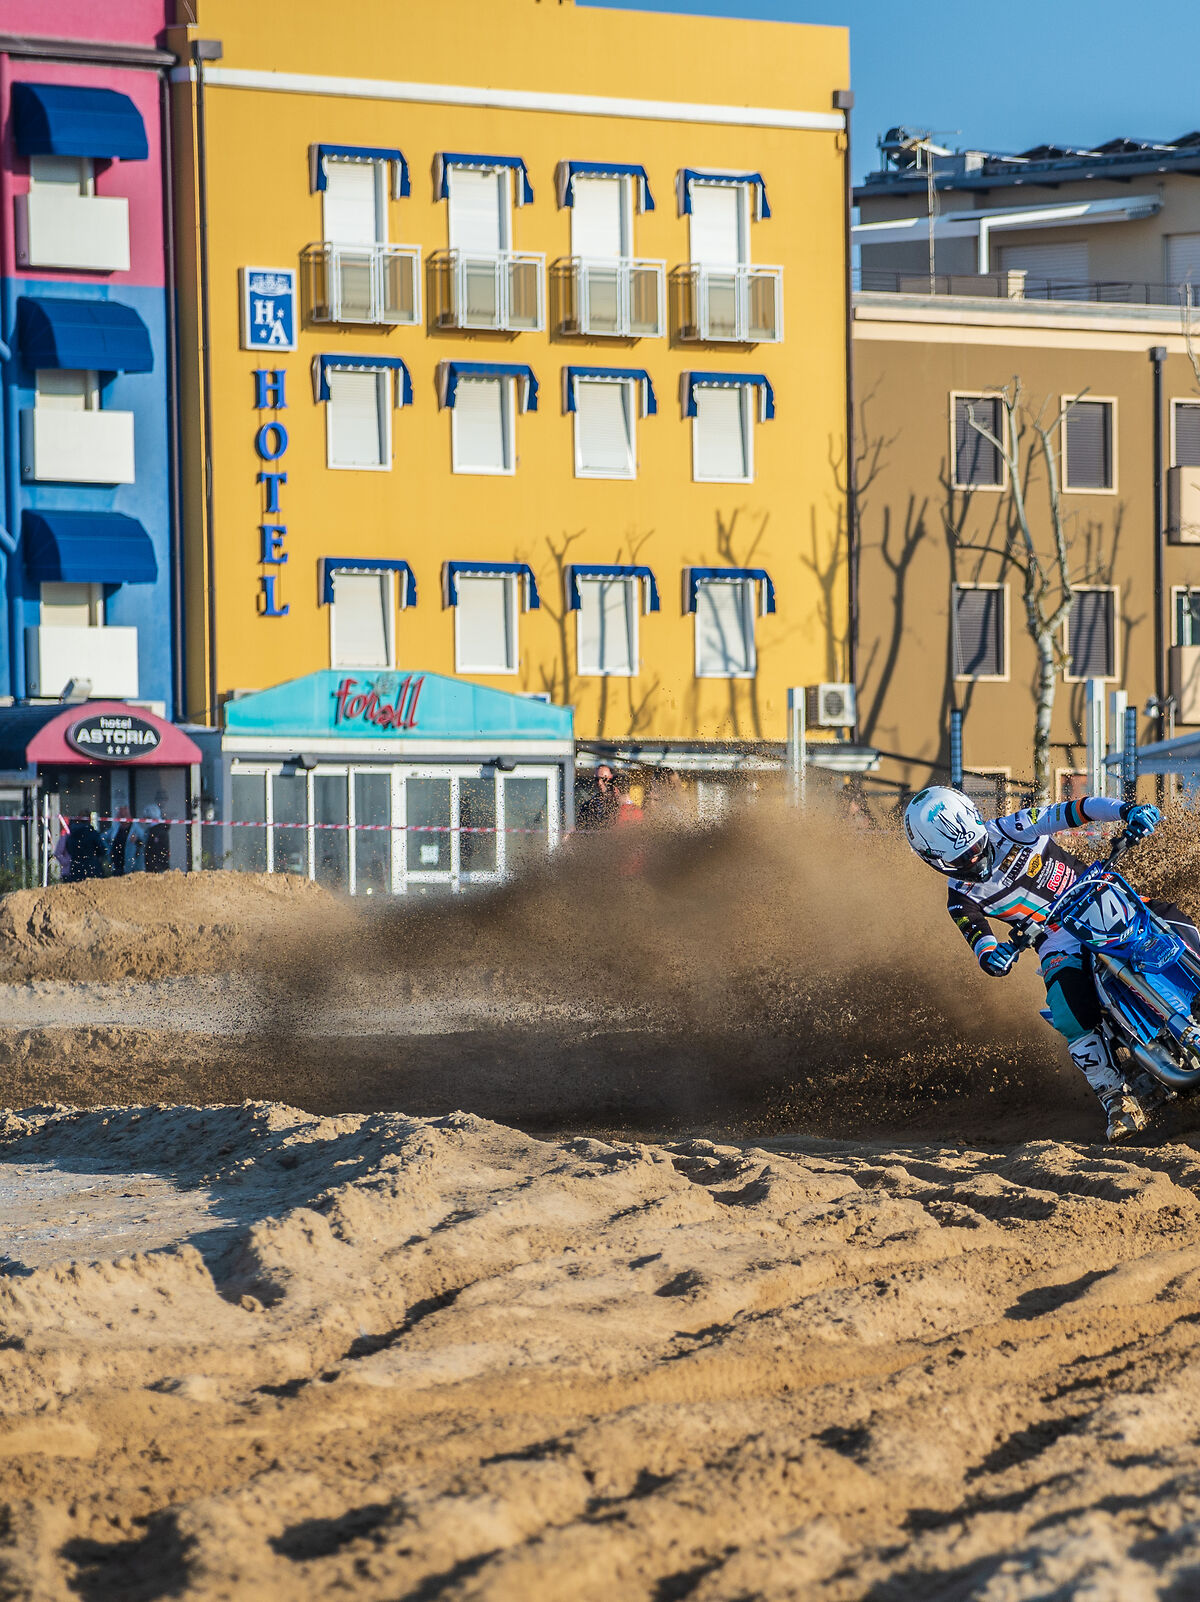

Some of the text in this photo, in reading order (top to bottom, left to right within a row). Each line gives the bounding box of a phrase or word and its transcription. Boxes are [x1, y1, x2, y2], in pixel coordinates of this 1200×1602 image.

[254, 368, 290, 617] HOTEL
[76, 728, 158, 745] ASTORIA
[100, 716, 132, 730] hotel
[1073, 881, 1137, 941] 74
